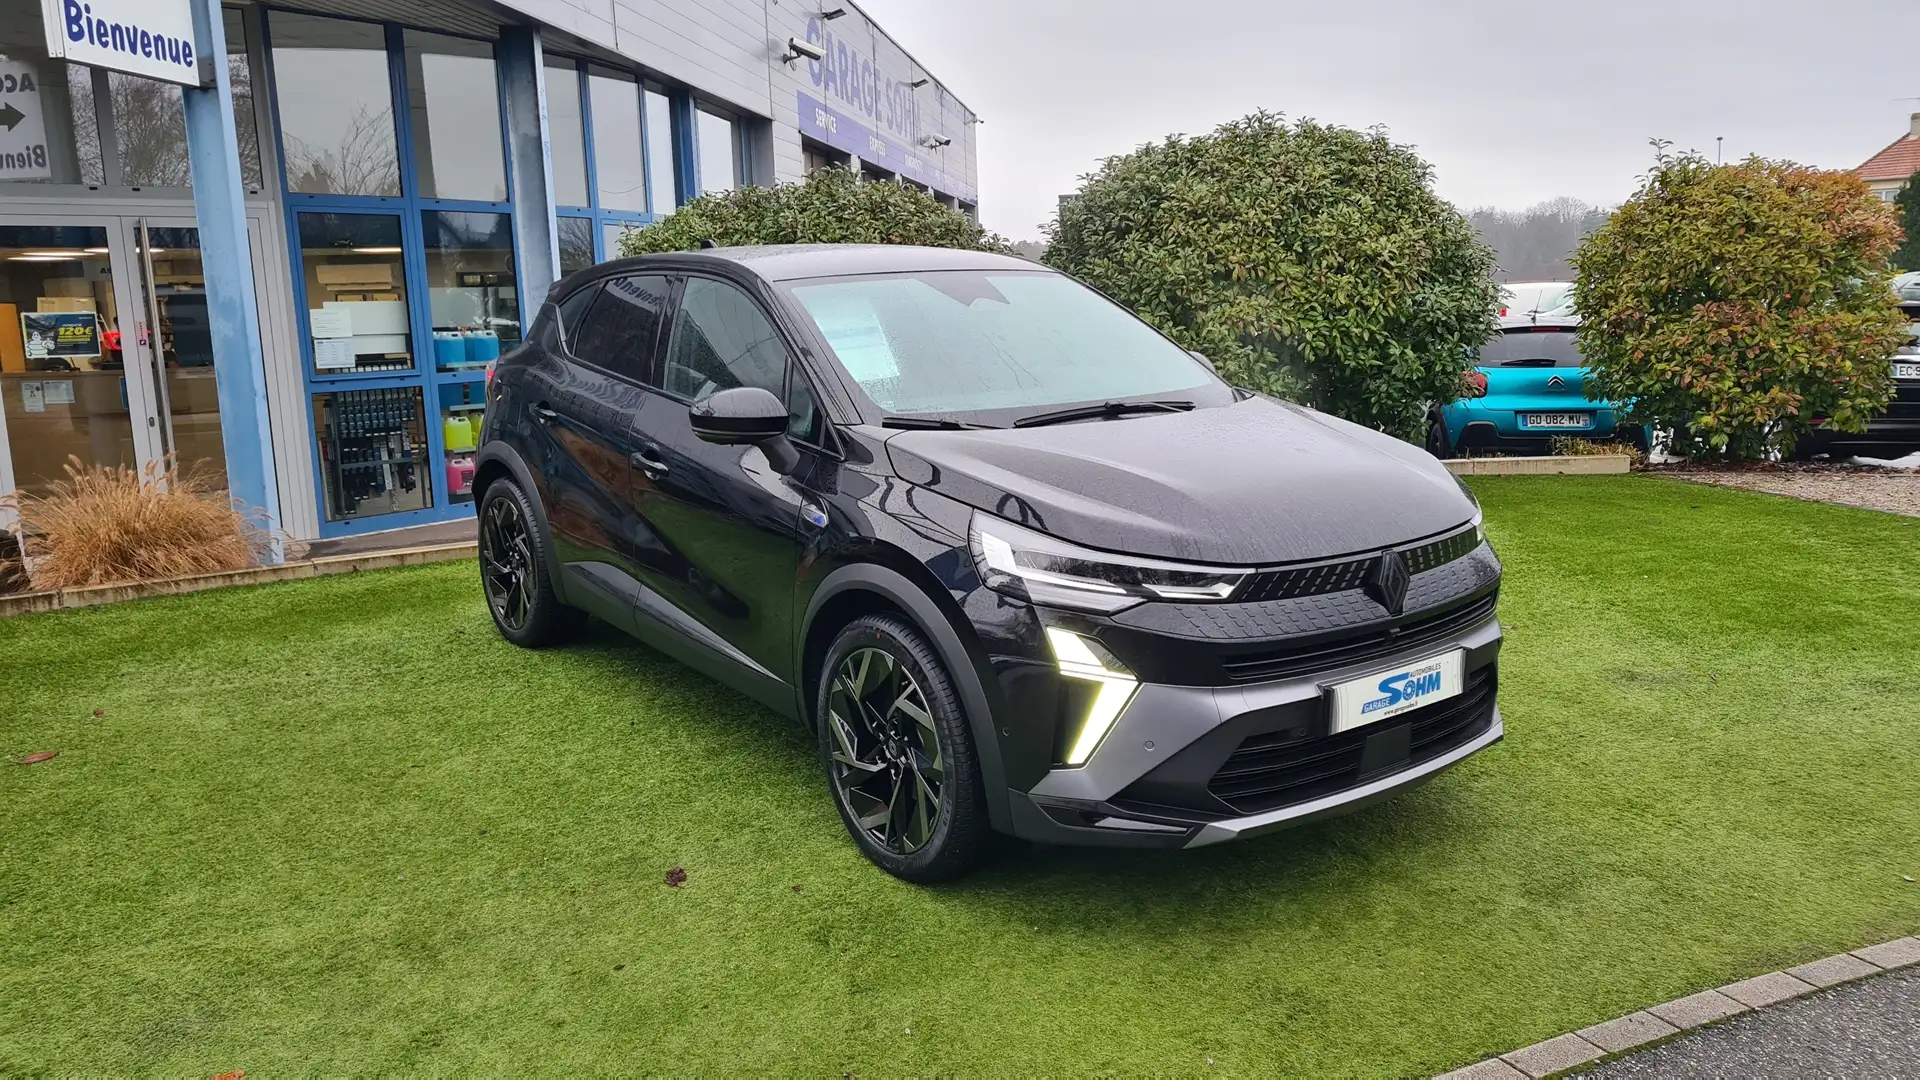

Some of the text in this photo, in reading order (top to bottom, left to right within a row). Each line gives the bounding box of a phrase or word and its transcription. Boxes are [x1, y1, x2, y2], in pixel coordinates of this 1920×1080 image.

[64, 0, 193, 67] Bienvenue
[806, 17, 882, 123] GARAGE
[815, 107, 837, 134] SERVICE
[58, 326, 94, 336] 120€
[1409, 662, 1442, 678] AUTOMOBILES
[1378, 671, 1441, 705] SOHM
[1363, 698, 1391, 713] GARAGE
